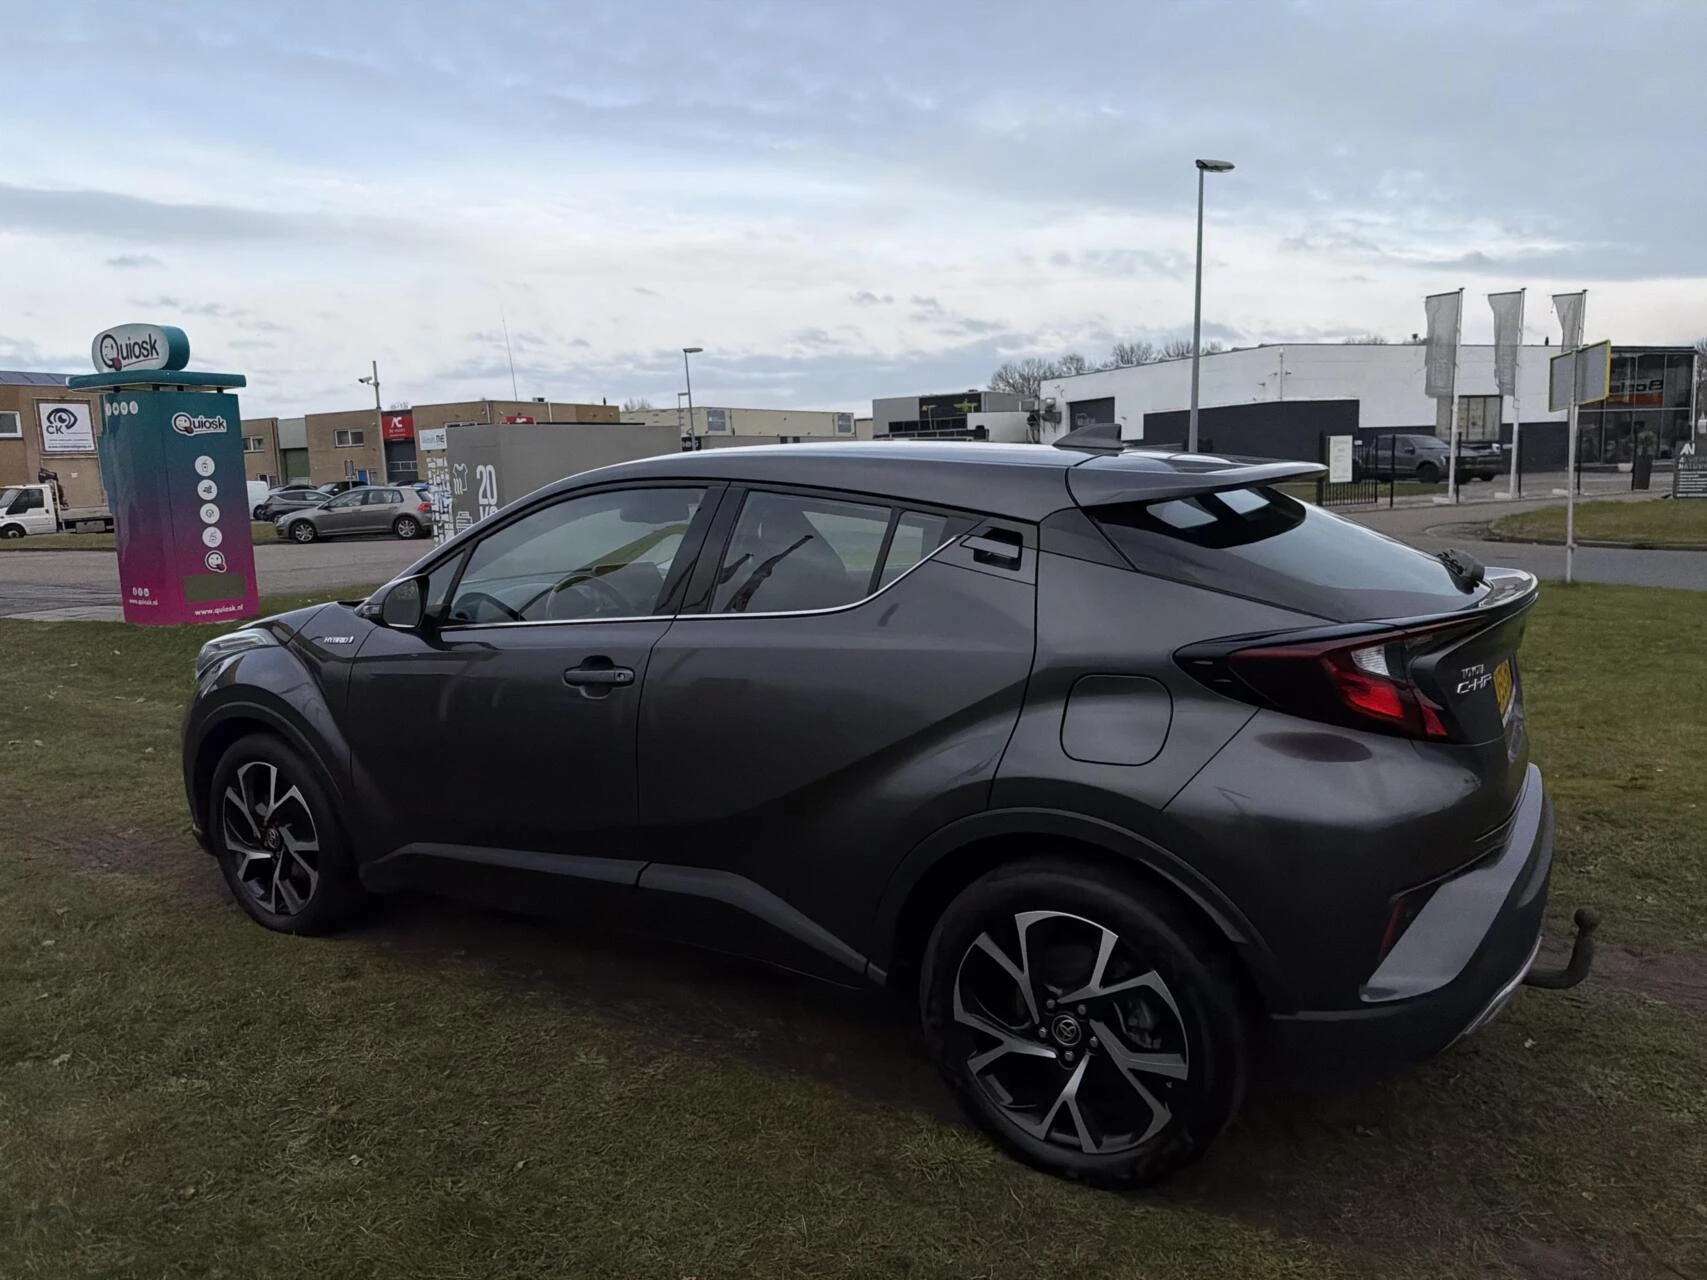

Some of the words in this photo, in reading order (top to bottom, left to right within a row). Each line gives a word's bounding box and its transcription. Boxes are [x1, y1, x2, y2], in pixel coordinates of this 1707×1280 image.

[100, 333, 159, 371] Quiosk
[46, 425, 64, 434] CK
[173, 413, 226, 433] Quiosk
[476, 464, 497, 505] 20
[194, 603, 243, 616] www.quiosk.nl
